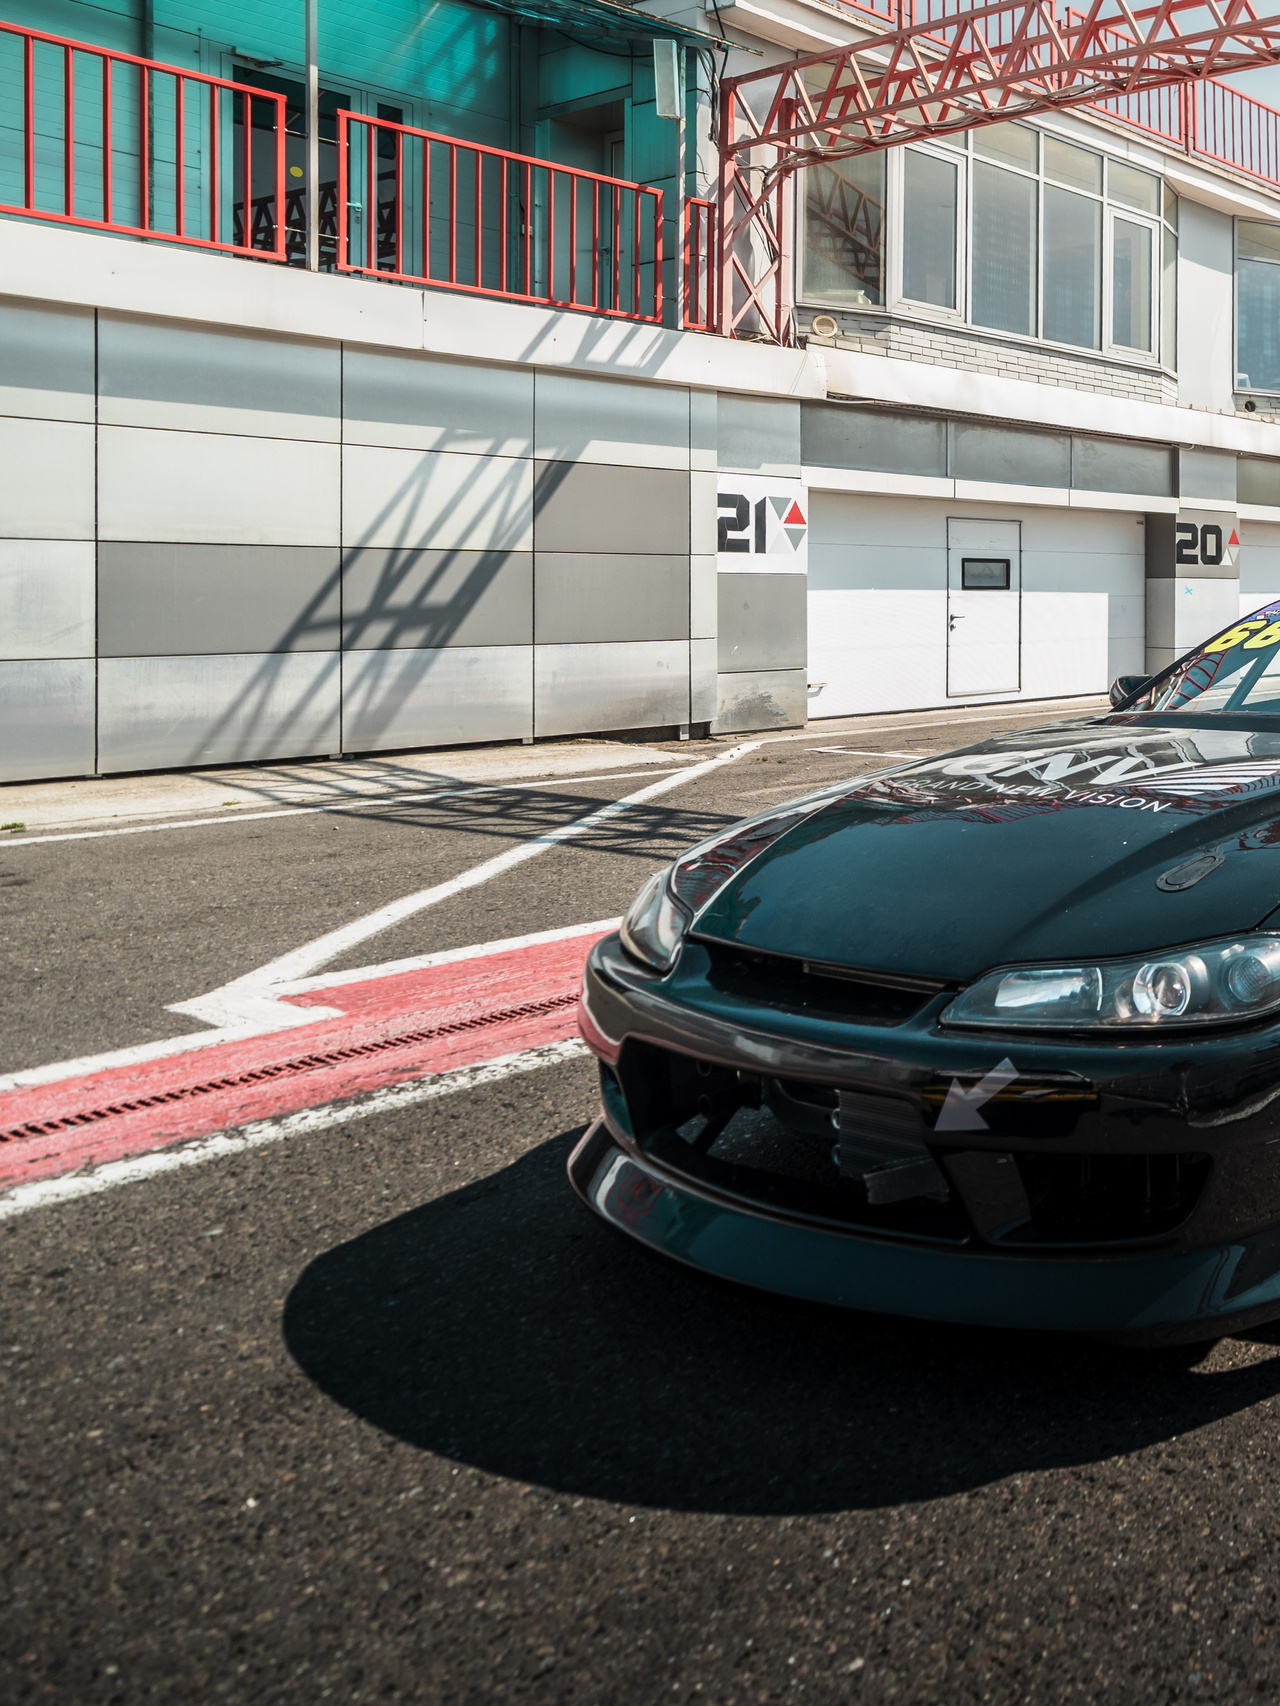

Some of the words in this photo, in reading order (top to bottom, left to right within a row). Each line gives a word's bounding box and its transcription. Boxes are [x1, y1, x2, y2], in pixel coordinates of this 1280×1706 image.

[717, 493, 766, 554] 21
[1176, 523, 1222, 565] 20
[986, 783, 1062, 798] NEW
[1064, 790, 1172, 813] VISION
